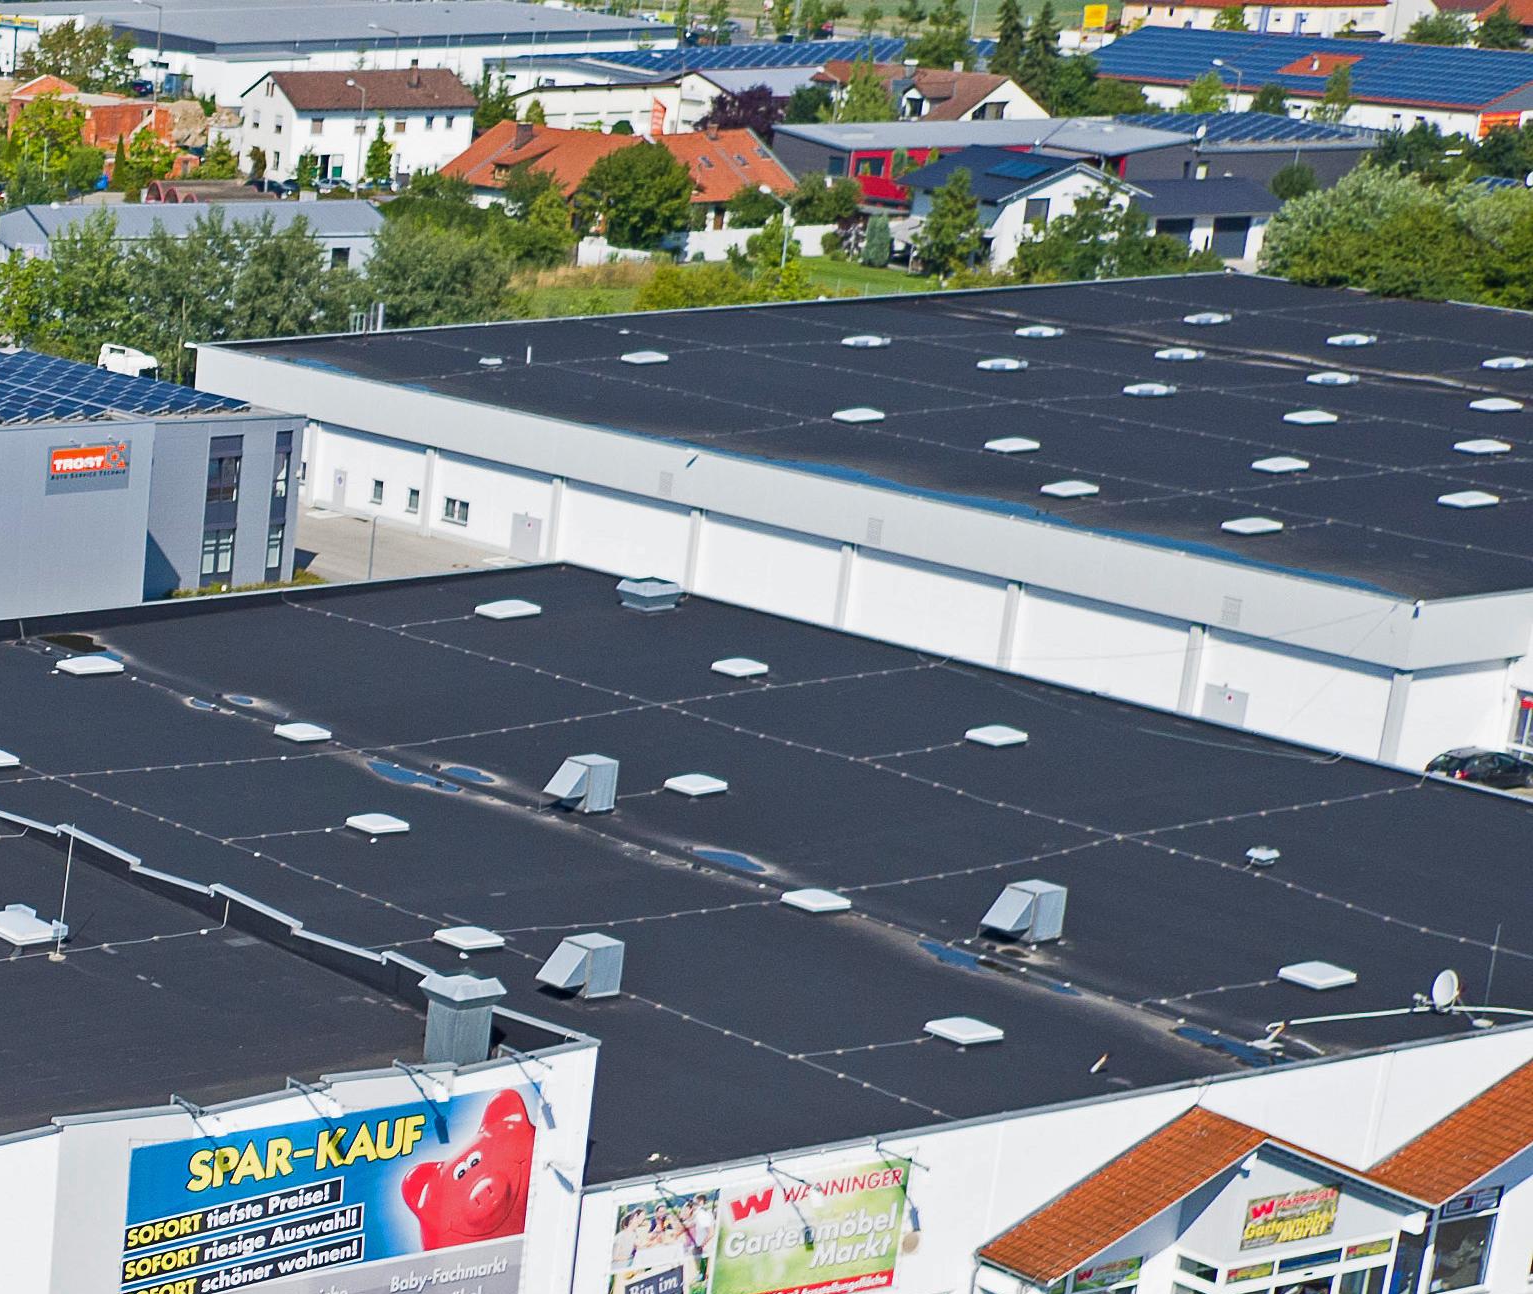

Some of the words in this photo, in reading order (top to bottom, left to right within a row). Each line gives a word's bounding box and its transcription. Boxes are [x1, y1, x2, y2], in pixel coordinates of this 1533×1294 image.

[53, 456, 104, 471] TROST
[186, 1114, 427, 1193] SPAR-KAUF
[127, 1213, 203, 1248] SOFORT
[206, 1203, 264, 1230] tiefste
[267, 1184, 331, 1216] Preise!
[730, 1188, 774, 1222] W
[124, 1246, 200, 1280] SOFORT
[203, 1236, 266, 1262] riesige
[270, 1208, 359, 1246] Auswahl!
[724, 1202, 898, 1259] Gartenmöbel
[809, 1232, 894, 1269] Markt
[201, 1264, 275, 1293] schöner
[278, 1239, 359, 1275] wohnen!
[389, 1255, 509, 1294] Baby-Fachmarkt
[658, 1276, 679, 1294] im
